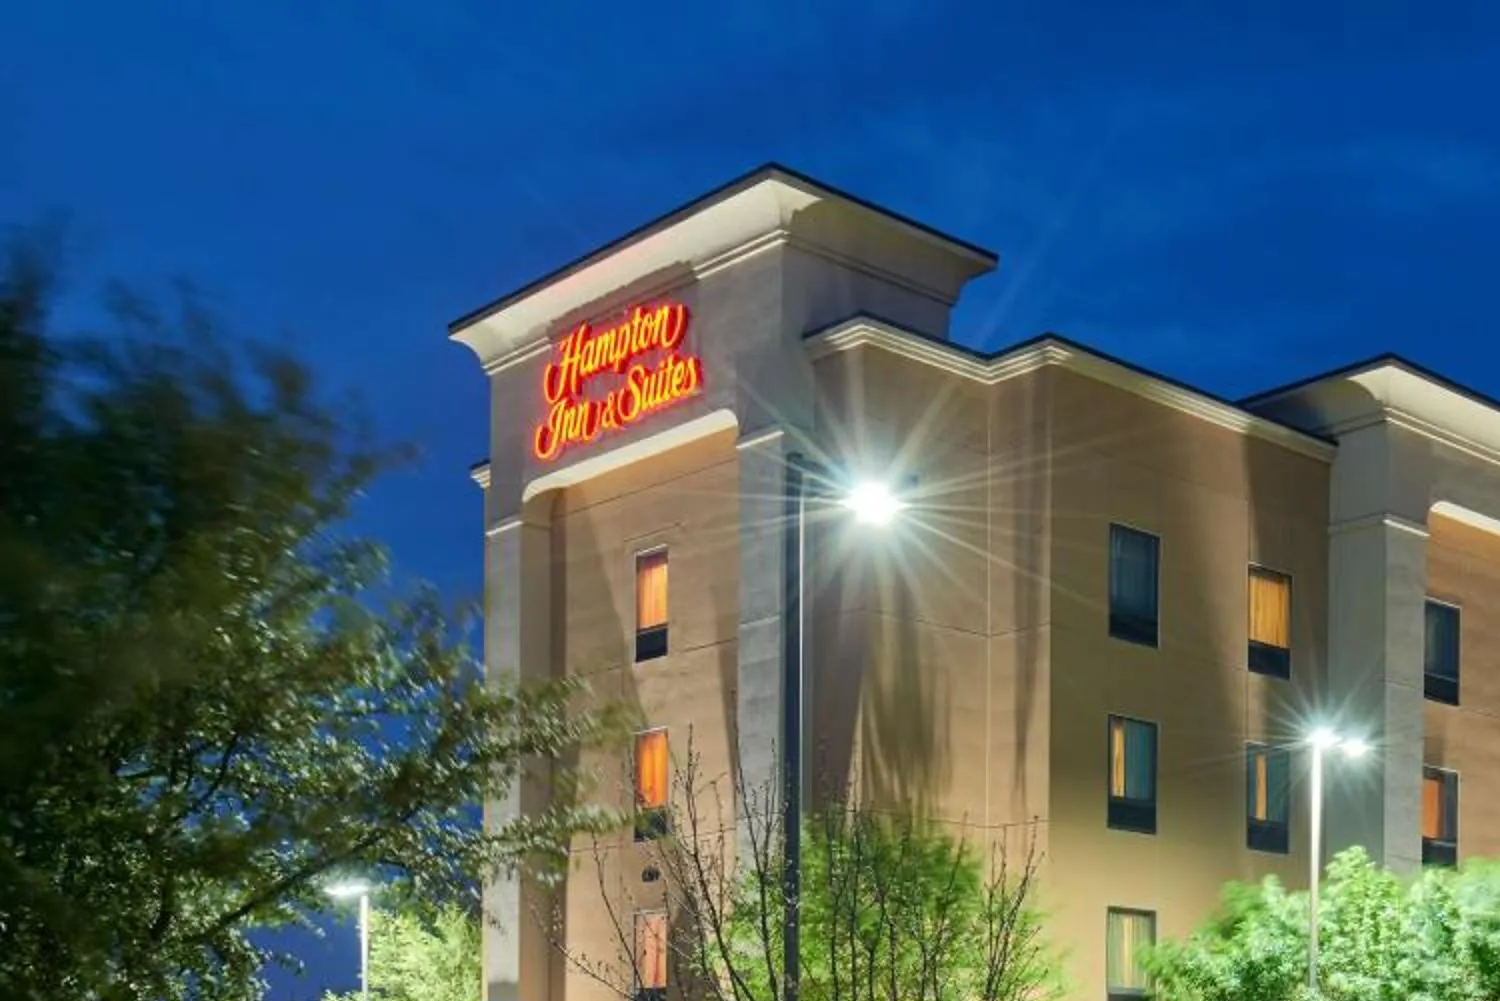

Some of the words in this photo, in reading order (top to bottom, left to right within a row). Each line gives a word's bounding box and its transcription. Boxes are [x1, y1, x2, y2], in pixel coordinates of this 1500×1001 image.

[543, 303, 688, 403] Hampton
[535, 397, 602, 459] Inn
[602, 391, 624, 430] &
[618, 354, 702, 421] Suites
